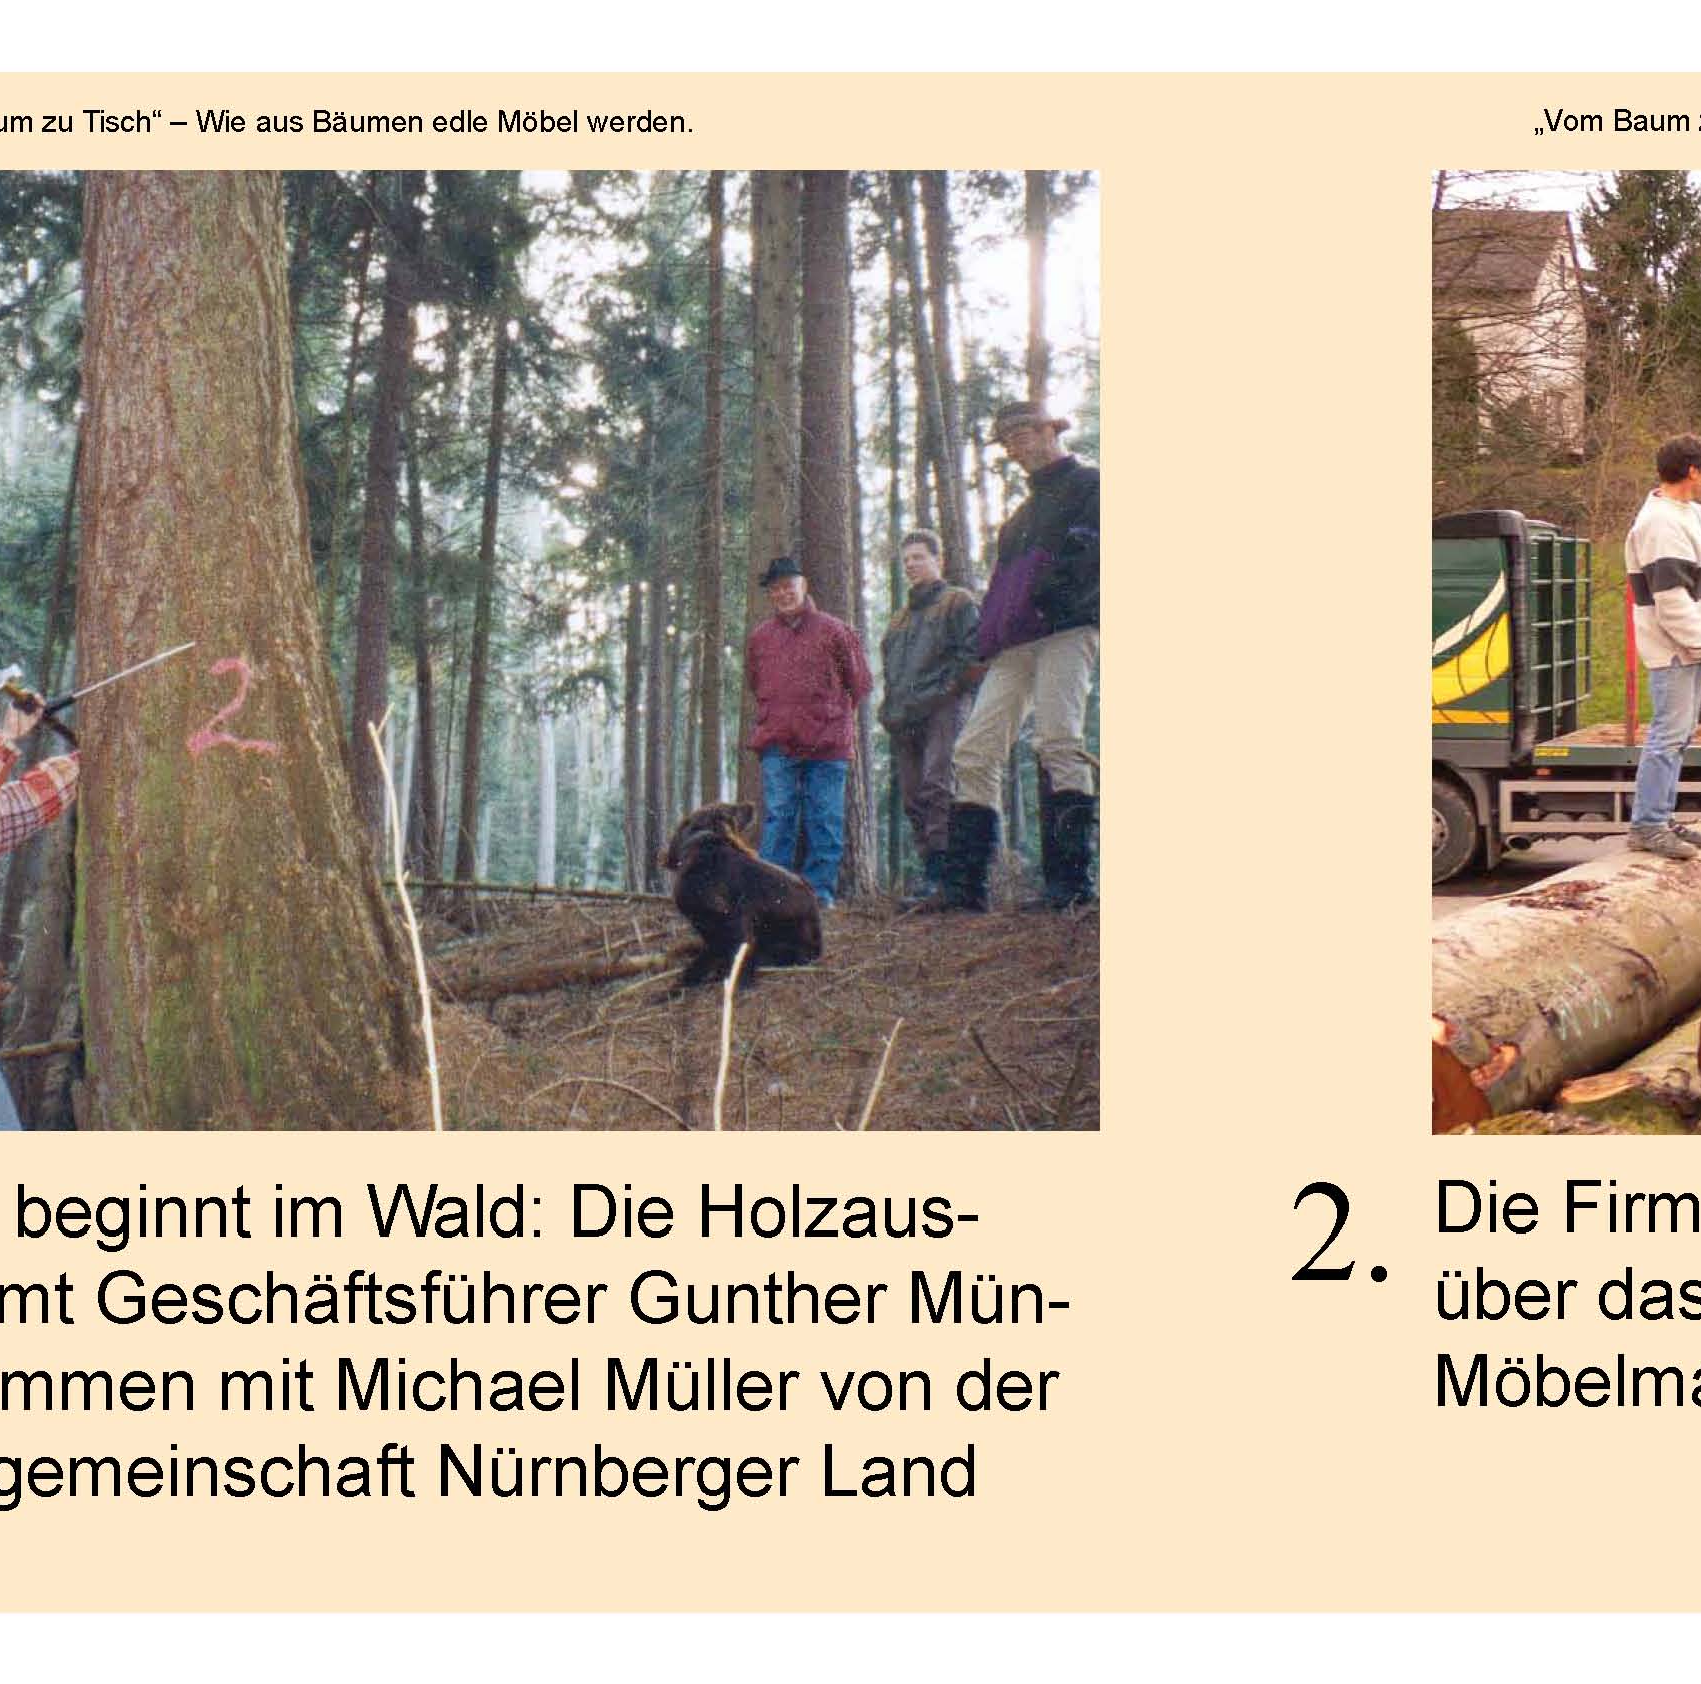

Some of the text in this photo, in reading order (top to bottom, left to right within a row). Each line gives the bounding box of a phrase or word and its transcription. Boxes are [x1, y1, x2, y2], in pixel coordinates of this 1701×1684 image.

[42, 116, 72, 132] zu
[196, 110, 245, 132] Wie
[257, 116, 303, 132] aus
[314, 110, 422, 132] Bäumen
[433, 110, 487, 132] edle
[499, 110, 577, 132] Möbel
[587, 110, 692, 132] werden.
[1615, 109, 1689, 131] Baum
[187, 656, 278, 755] 2
[18, 1184, 251, 1252] beginnt
[276, 1184, 341, 1237] im
[367, 1184, 540, 1238] Wald:
[574, 1184, 673, 1238] Die
[702, 1184, 978, 1238] Holzaus-
[1292, 1182, 1387, 1282] 2.
[1439, 1180, 1538, 1234] Die
[98, 1270, 608, 1324] Geschäftsführer
[631, 1270, 888, 1324] Gunther
[912, 1271, 1069, 1324] Mün-
[1438, 1267, 1578, 1320] über
[222, 1358, 314, 1411] mit
[339, 1358, 578, 1411] Michael
[608, 1358, 800, 1411] Müller
[820, 1371, 930, 1411] von
[957, 1358, 1060, 1411] der
[441, 1444, 800, 1511] Nürnberger
[825, 1444, 974, 1497] Land
